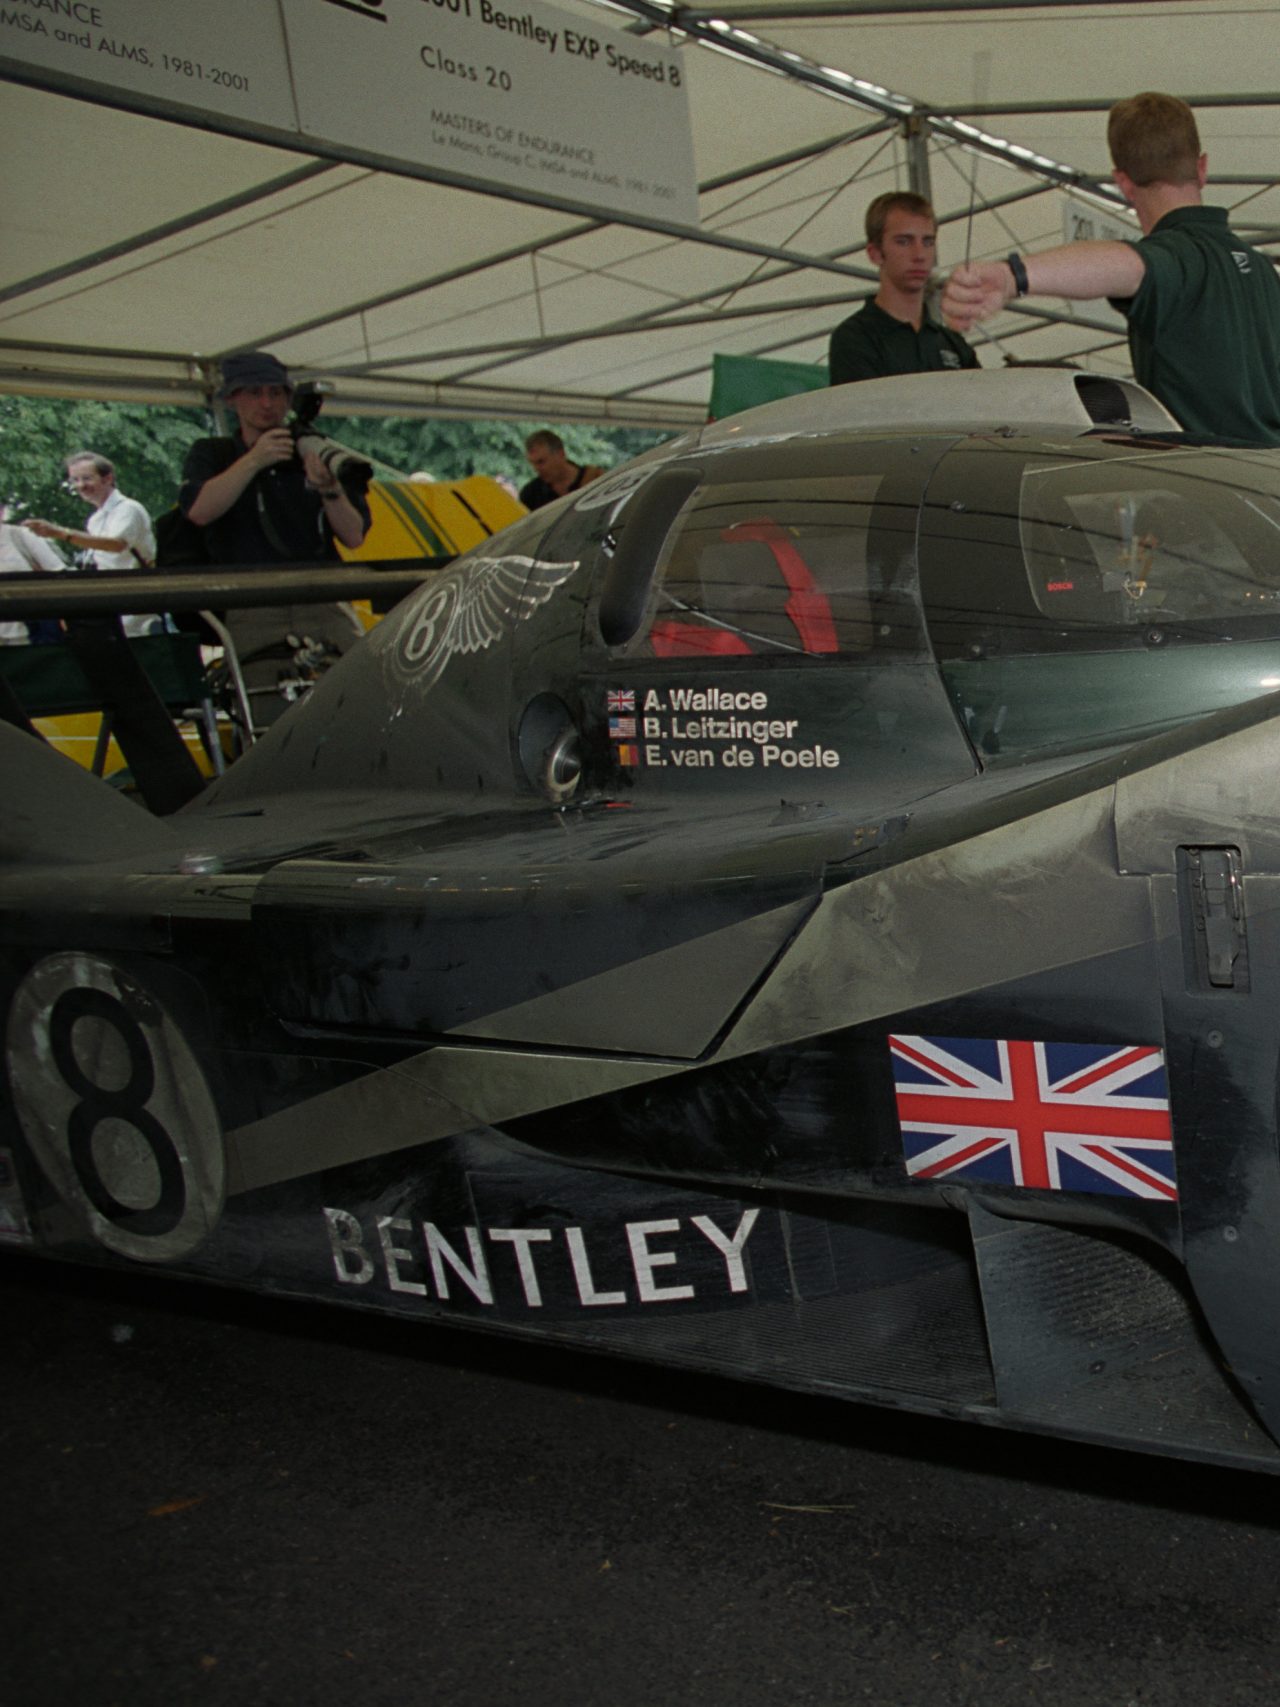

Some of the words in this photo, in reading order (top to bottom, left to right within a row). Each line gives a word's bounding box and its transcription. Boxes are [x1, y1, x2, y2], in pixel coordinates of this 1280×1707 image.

[10, 0, 103, 27] ANCE
[0, 8, 48, 37] MSA
[54, 27, 92, 49] and
[98, 38, 154, 68] ALMS,
[162, 54, 249, 91] 1981-2001
[420, 45, 478, 81] Class
[485, 65, 512, 91] 20
[481, 0, 558, 53] Bentley
[564, 29, 600, 60] EXP
[605, 43, 664, 82] Speed
[669, 64, 681, 87] 8
[430, 109, 491, 138] MASTERS
[495, 125, 513, 142] OF
[517, 132, 594, 165] ENDURANCE
[643, 689, 668, 711] A.
[669, 688, 768, 711] Wallace
[643, 717, 668, 739] B.
[672, 716, 799, 744] Leitzinger
[645, 745, 668, 767] E.
[671, 749, 714, 767] van
[722, 745, 755, 768] de
[762, 745, 840, 768] Poele
[51, 986, 186, 1237] 8
[324, 1207, 760, 1307] BENTLEY
